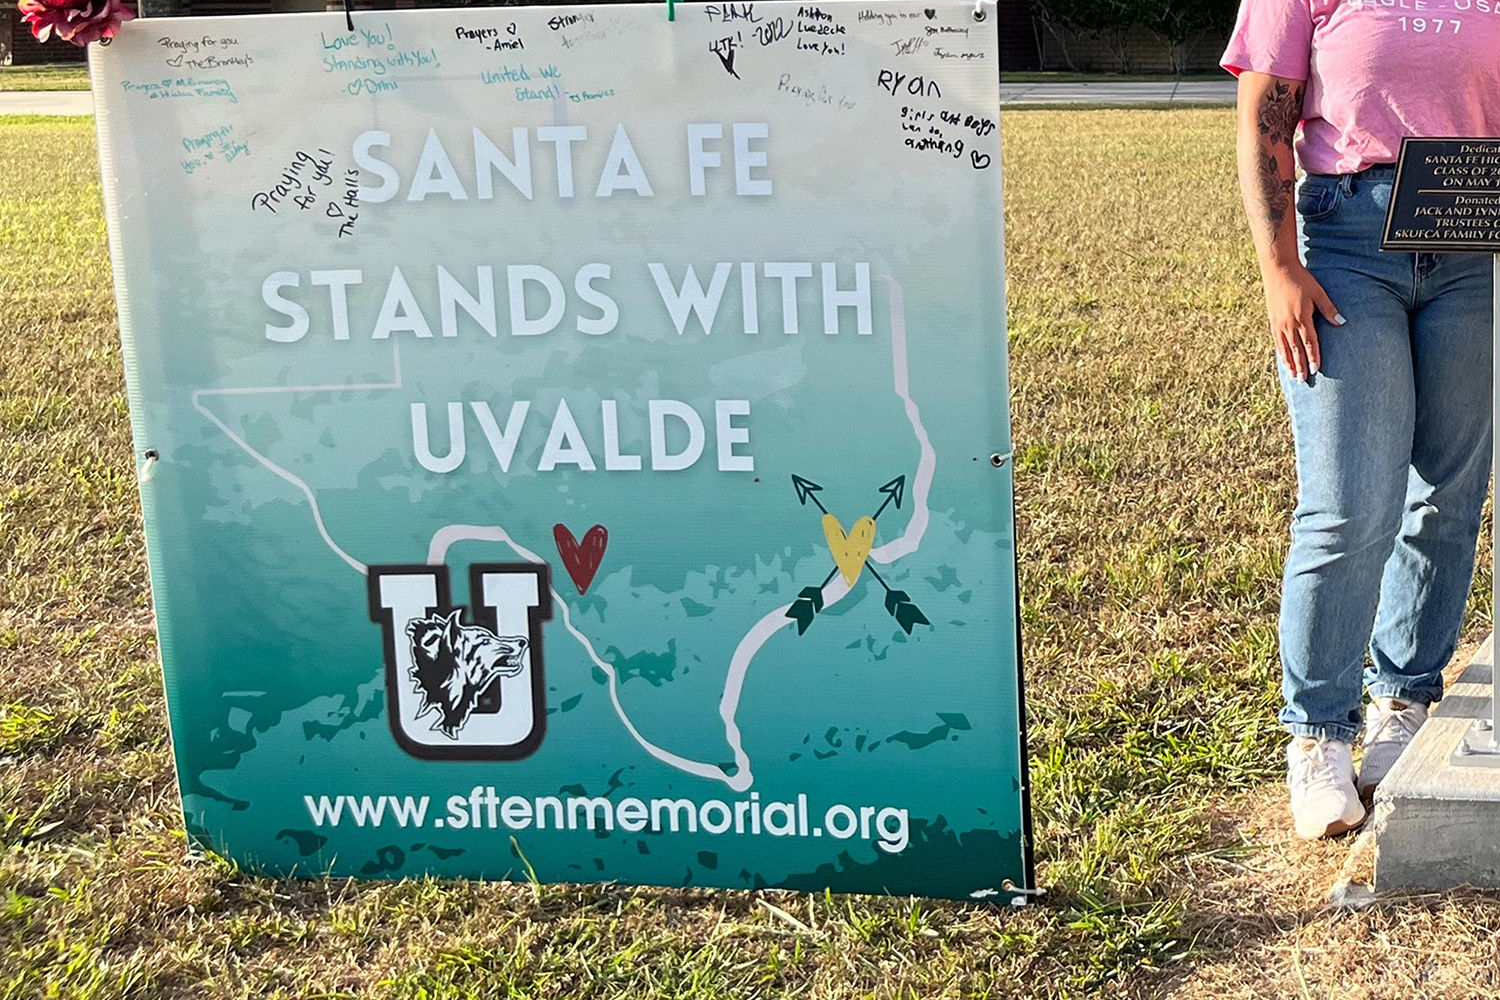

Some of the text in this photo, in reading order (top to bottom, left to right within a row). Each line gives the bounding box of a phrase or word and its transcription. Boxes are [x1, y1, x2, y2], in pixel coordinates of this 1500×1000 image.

[456, 26, 498, 43] Prayers
[1398, 16, 1462, 34] 1977
[157, 35, 240, 53] Praying for you
[321, 23, 395, 51] Love You!
[797, 37, 820, 52] Love
[323, 54, 387, 75] Standing
[387, 52, 414, 67] with
[482, 64, 561, 85] United We
[877, 69, 941, 98] Ryan
[515, 85, 560, 101] Stand!
[901, 106, 935, 121] girls
[352, 122, 773, 203] SANTA FE
[1424, 156, 1462, 165] SANTA
[1465, 156, 1479, 165] FE
[1433, 166, 1469, 176] CLASS
[1471, 167, 1489, 176] OF
[252, 151, 318, 213] Praying
[1442, 177, 1463, 187] ON
[1466, 178, 1492, 187] MAY
[293, 185, 316, 210] for
[1414, 207, 1443, 217] JACK
[1445, 207, 1472, 216] AND
[338, 213, 359, 238] The
[1435, 218, 1490, 227] TRUSTEES
[1395, 229, 1440, 239] SKUFCA
[1443, 229, 1485, 239] FAMILY
[261, 262, 873, 343] STANDS WITH
[410, 397, 755, 474] UVALDE
[367, 562, 554, 762] U
[304, 786, 910, 854] www.sftenmemorial.org
